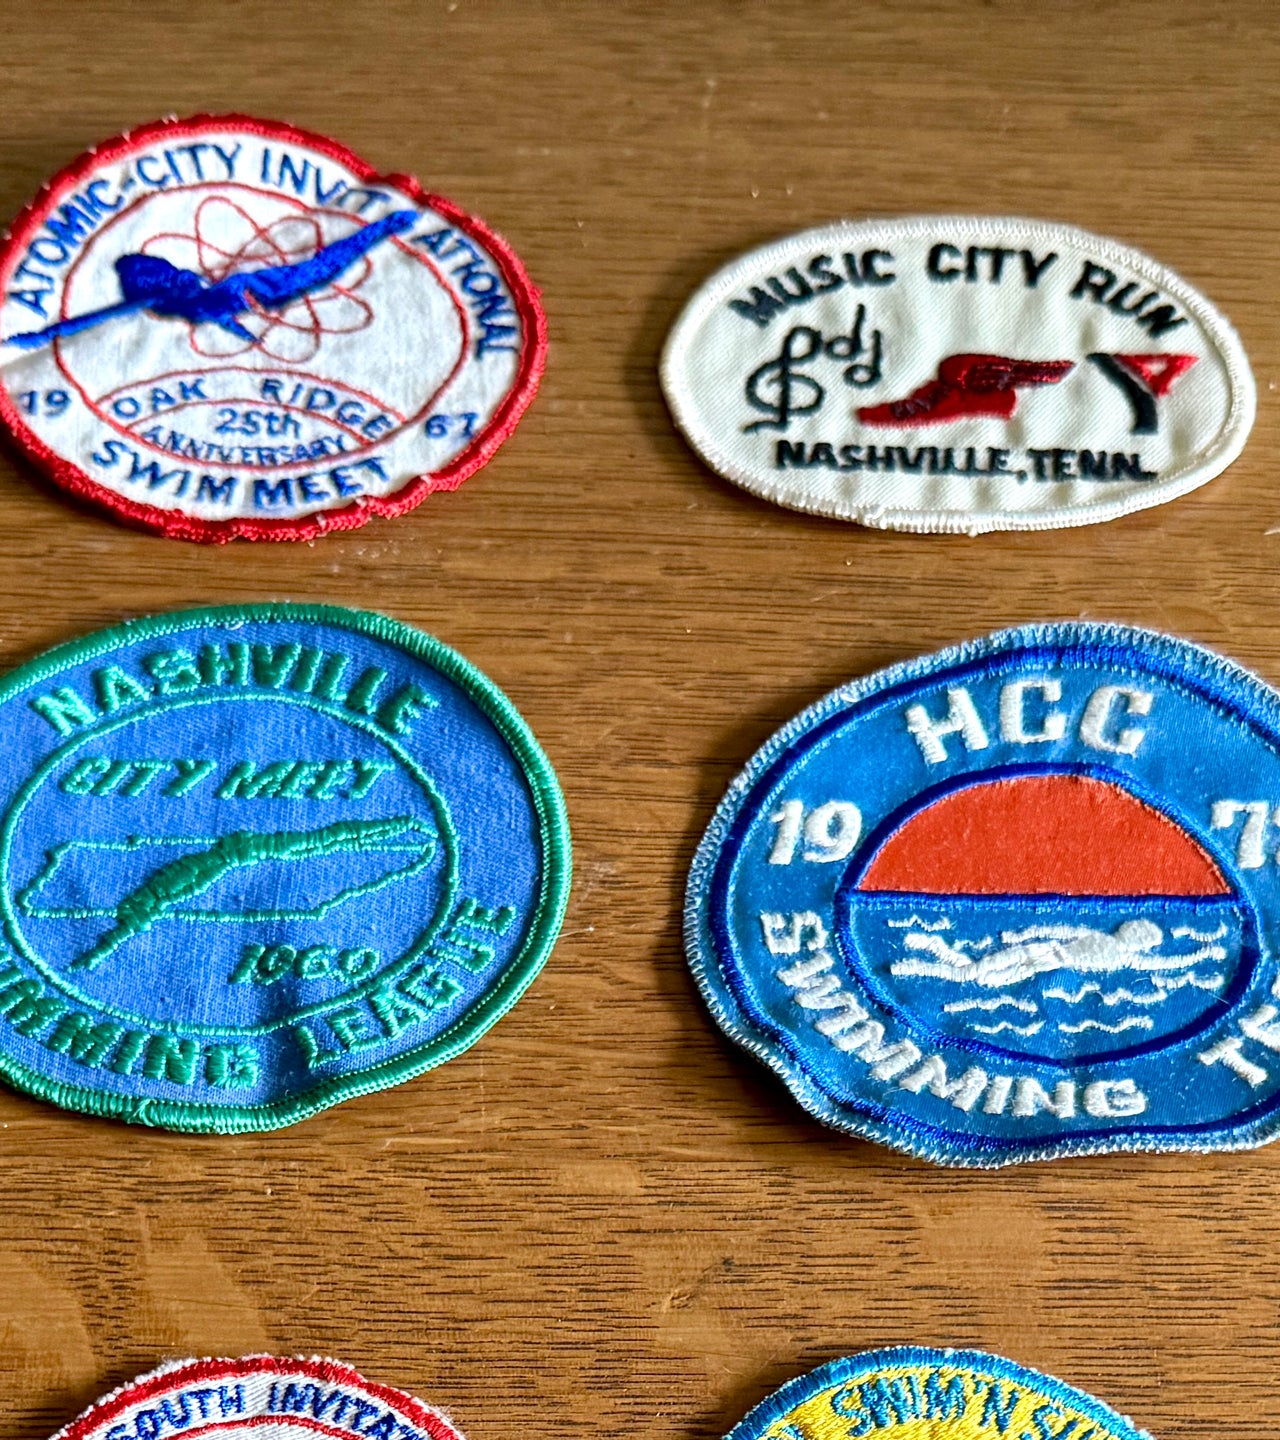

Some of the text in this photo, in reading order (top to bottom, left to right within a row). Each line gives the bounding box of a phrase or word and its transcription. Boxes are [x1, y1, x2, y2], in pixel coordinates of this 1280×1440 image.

[9, 142, 520, 363] ATOMIC-CITY INVITATIONAL
[726, 242, 1193, 340] MUSIC CITY RUN
[21, 389, 69, 417] 19
[111, 377, 393, 439] OAK RIDGE
[214, 407, 302, 438] 25th
[424, 411, 479, 440] 67
[91, 438, 394, 506] SWIM MEET
[140, 425, 350, 466] ANNIVERSARY
[32, 640, 440, 740] NASHVILLE
[904, 676, 1155, 765] HCC
[58, 756, 396, 801] CITY MEET
[766, 799, 864, 866] 19
[293, 896, 520, 1071] LEAGUE
[758, 909, 1149, 1120] SWIMMING
